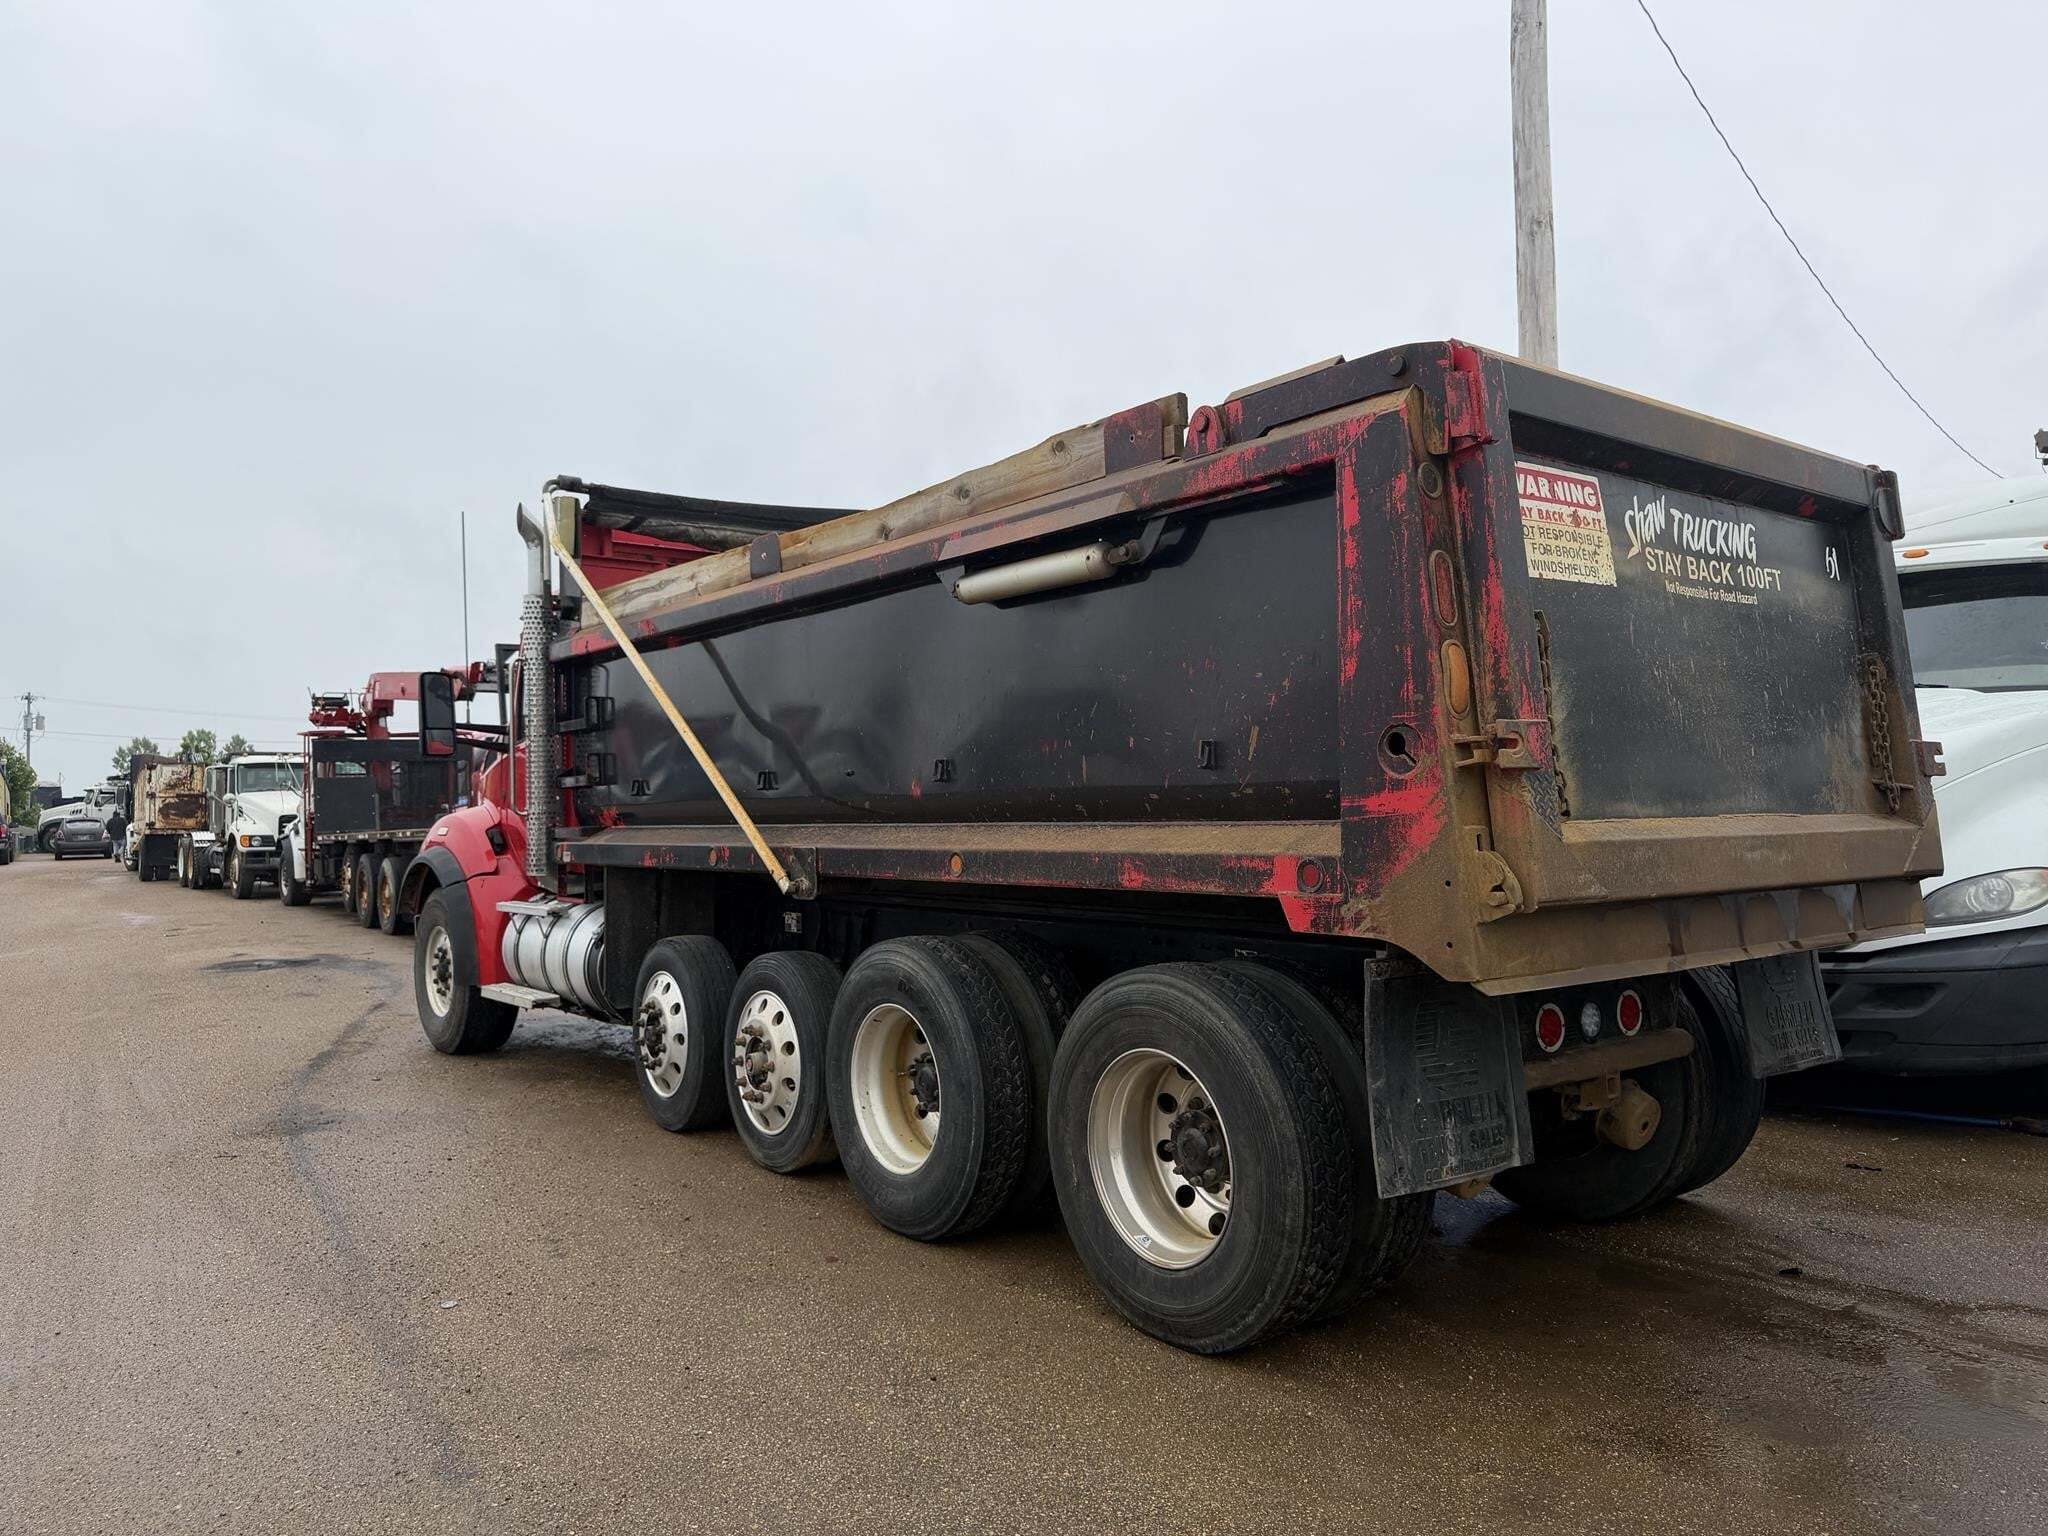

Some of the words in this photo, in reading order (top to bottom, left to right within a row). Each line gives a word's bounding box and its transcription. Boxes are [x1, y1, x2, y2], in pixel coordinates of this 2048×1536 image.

[1537, 508, 1565, 523] BACK
[1522, 524, 1535, 538] OT
[1538, 525, 1603, 549] RESPONSIBLE
[1625, 495, 1665, 559] Shaw
[1670, 508, 1757, 564] TRUCKING
[1532, 543, 1552, 556] FOR
[1555, 545, 1596, 563] BROKEN
[1645, 547, 1681, 576] STAY
[1687, 556, 1734, 585] BACK
[1738, 564, 1781, 591] 100FT
[1665, 580, 1675, 593] Not
[1676, 582, 1709, 599] Responsible
[1709, 588, 1720, 600] For
[1720, 590, 1736, 602] Road
[1736, 591, 1757, 604] Hazard
